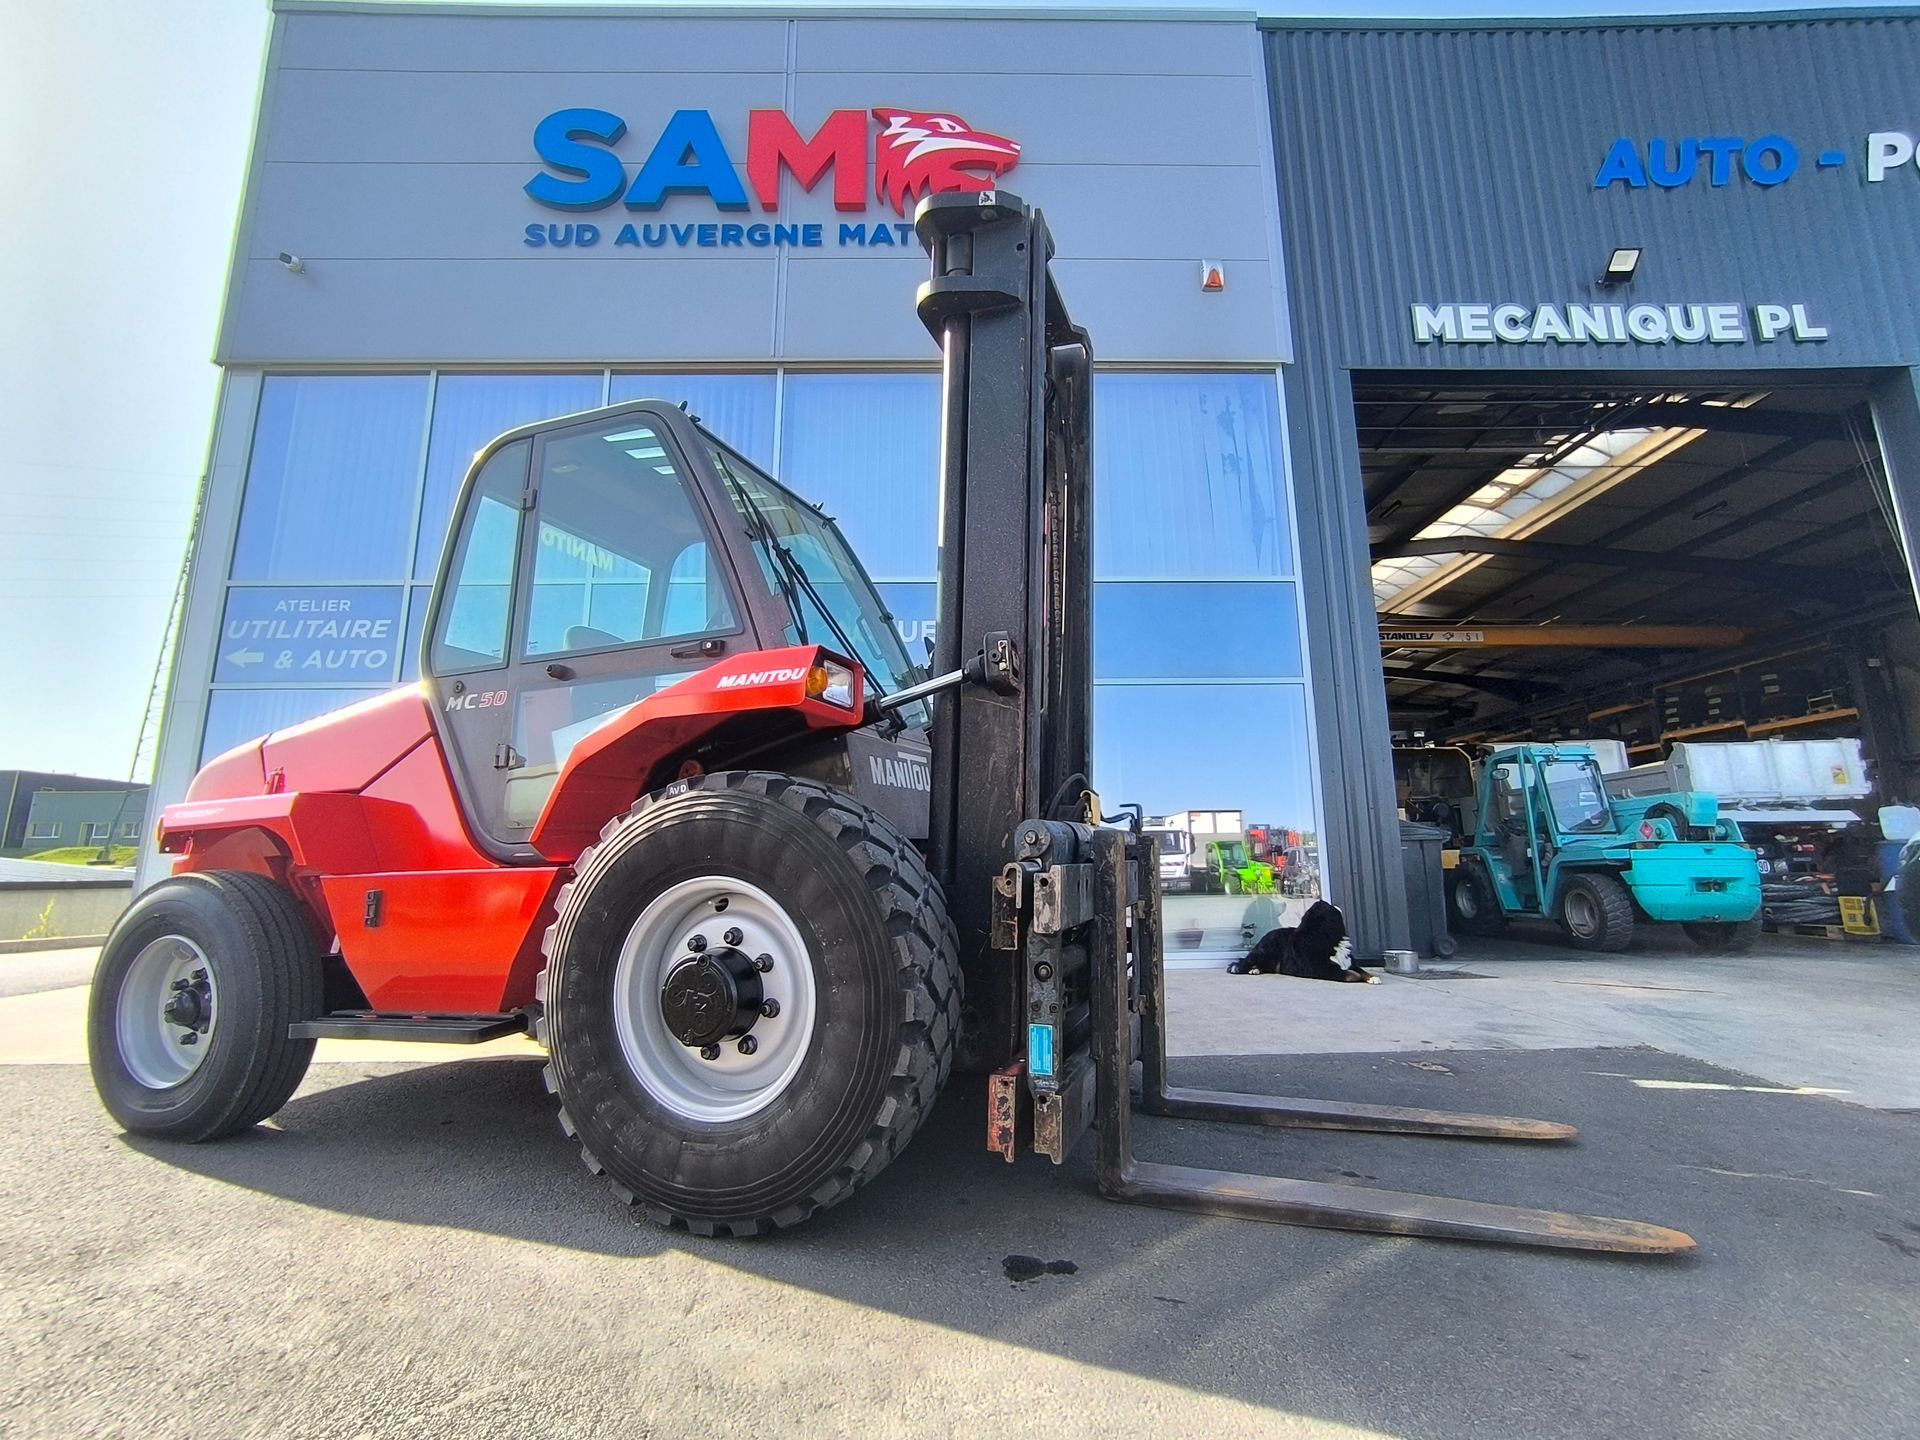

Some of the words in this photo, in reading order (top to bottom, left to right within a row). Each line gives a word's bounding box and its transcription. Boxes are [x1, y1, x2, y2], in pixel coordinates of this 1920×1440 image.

[523, 107, 867, 213] SAM
[1593, 134, 1798, 188] AUTO
[1867, 131, 1920, 183] P
[524, 222, 600, 247] SUD
[614, 223, 823, 248] AUVERGNE
[838, 223, 920, 247] MAT
[1412, 303, 1746, 345] MECANIQUE
[1756, 303, 1829, 343] PL
[274, 599, 351, 612] ATELIER
[227, 619, 392, 640] UTILITAIRE
[896, 619, 936, 643] UE
[273, 649, 294, 669] &
[301, 649, 389, 669] AUTO
[716, 667, 807, 689] MANITOU
[868, 751, 931, 792] MANITOU
